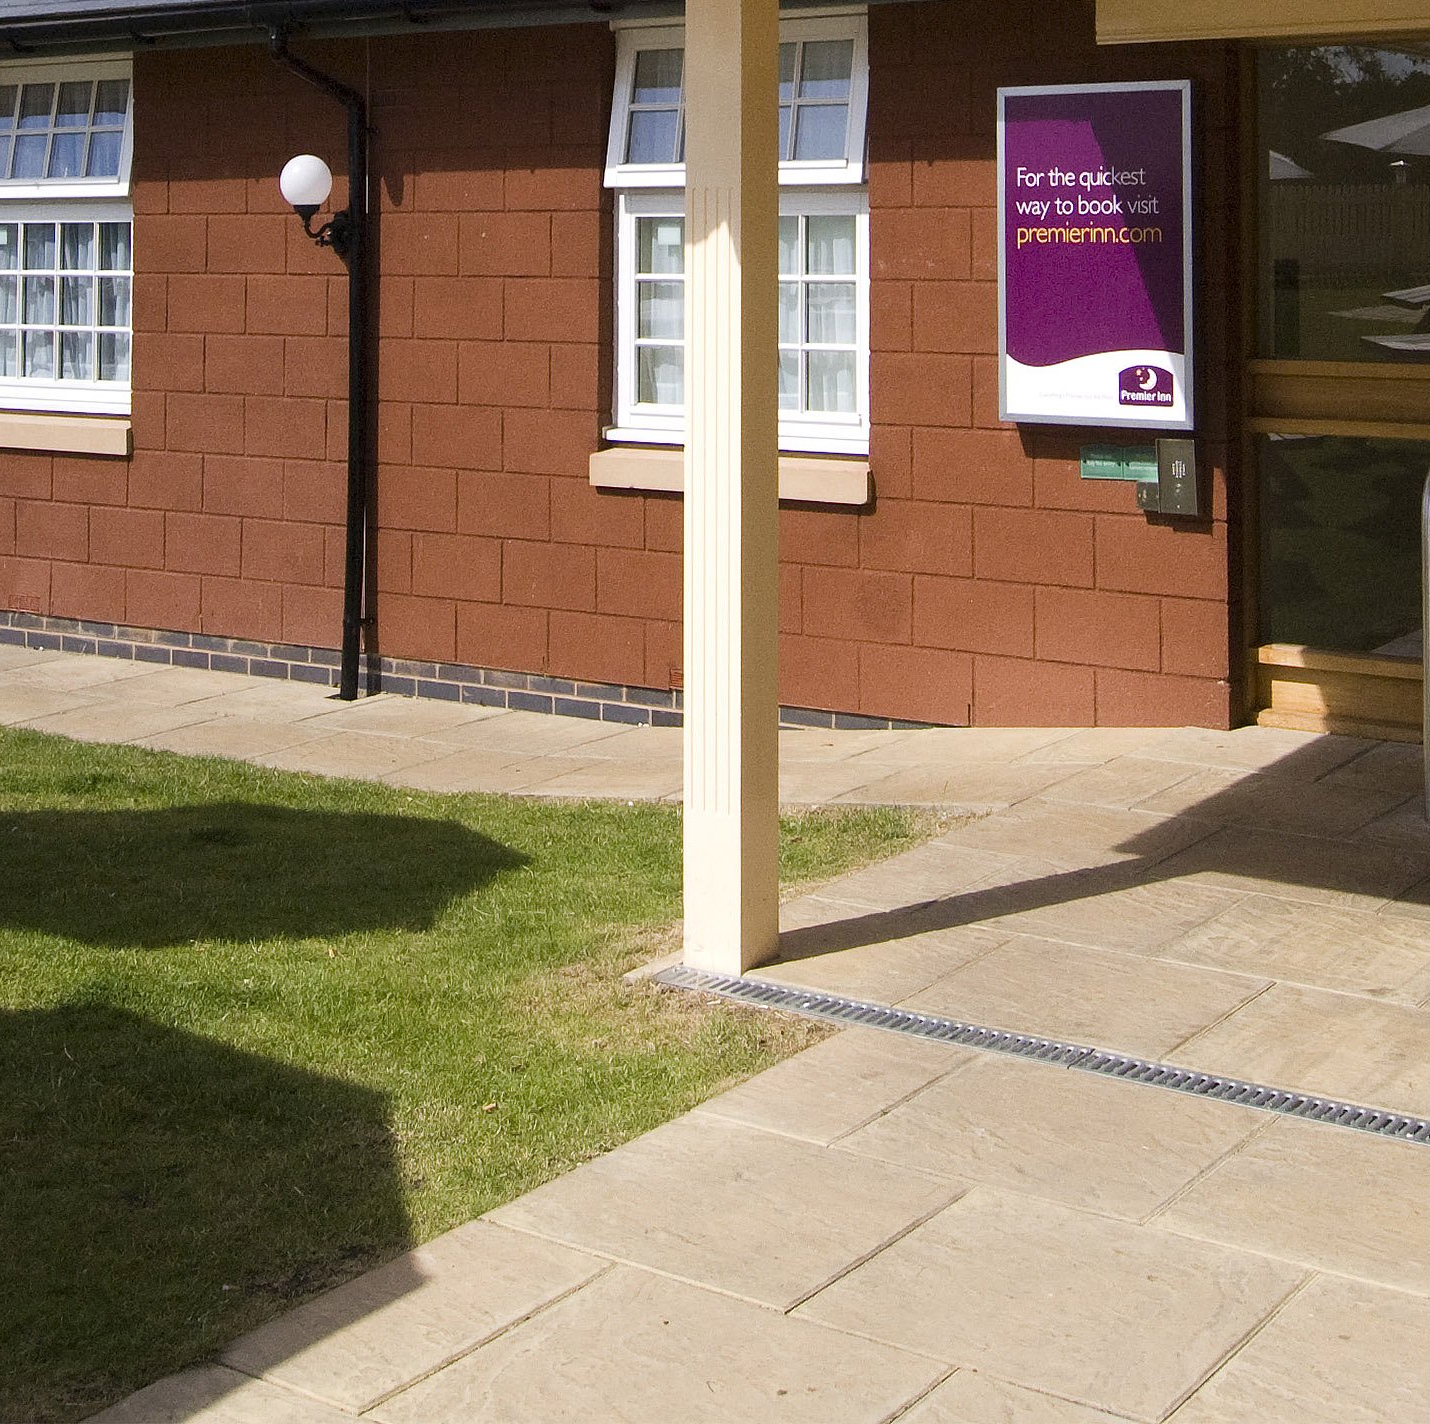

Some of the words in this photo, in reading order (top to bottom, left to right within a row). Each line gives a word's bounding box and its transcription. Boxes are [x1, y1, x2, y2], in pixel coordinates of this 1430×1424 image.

[1017, 166, 1045, 188] For
[1048, 166, 1076, 187] the
[1079, 165, 1147, 192] quickest
[1016, 200, 1051, 221] way
[1054, 197, 1074, 215] to
[1078, 194, 1123, 215] book
[1127, 194, 1160, 215] visit
[1017, 221, 1163, 250] premierinn.com
[1120, 389, 1157, 402] Premier
[1157, 390, 1172, 403] Inn
